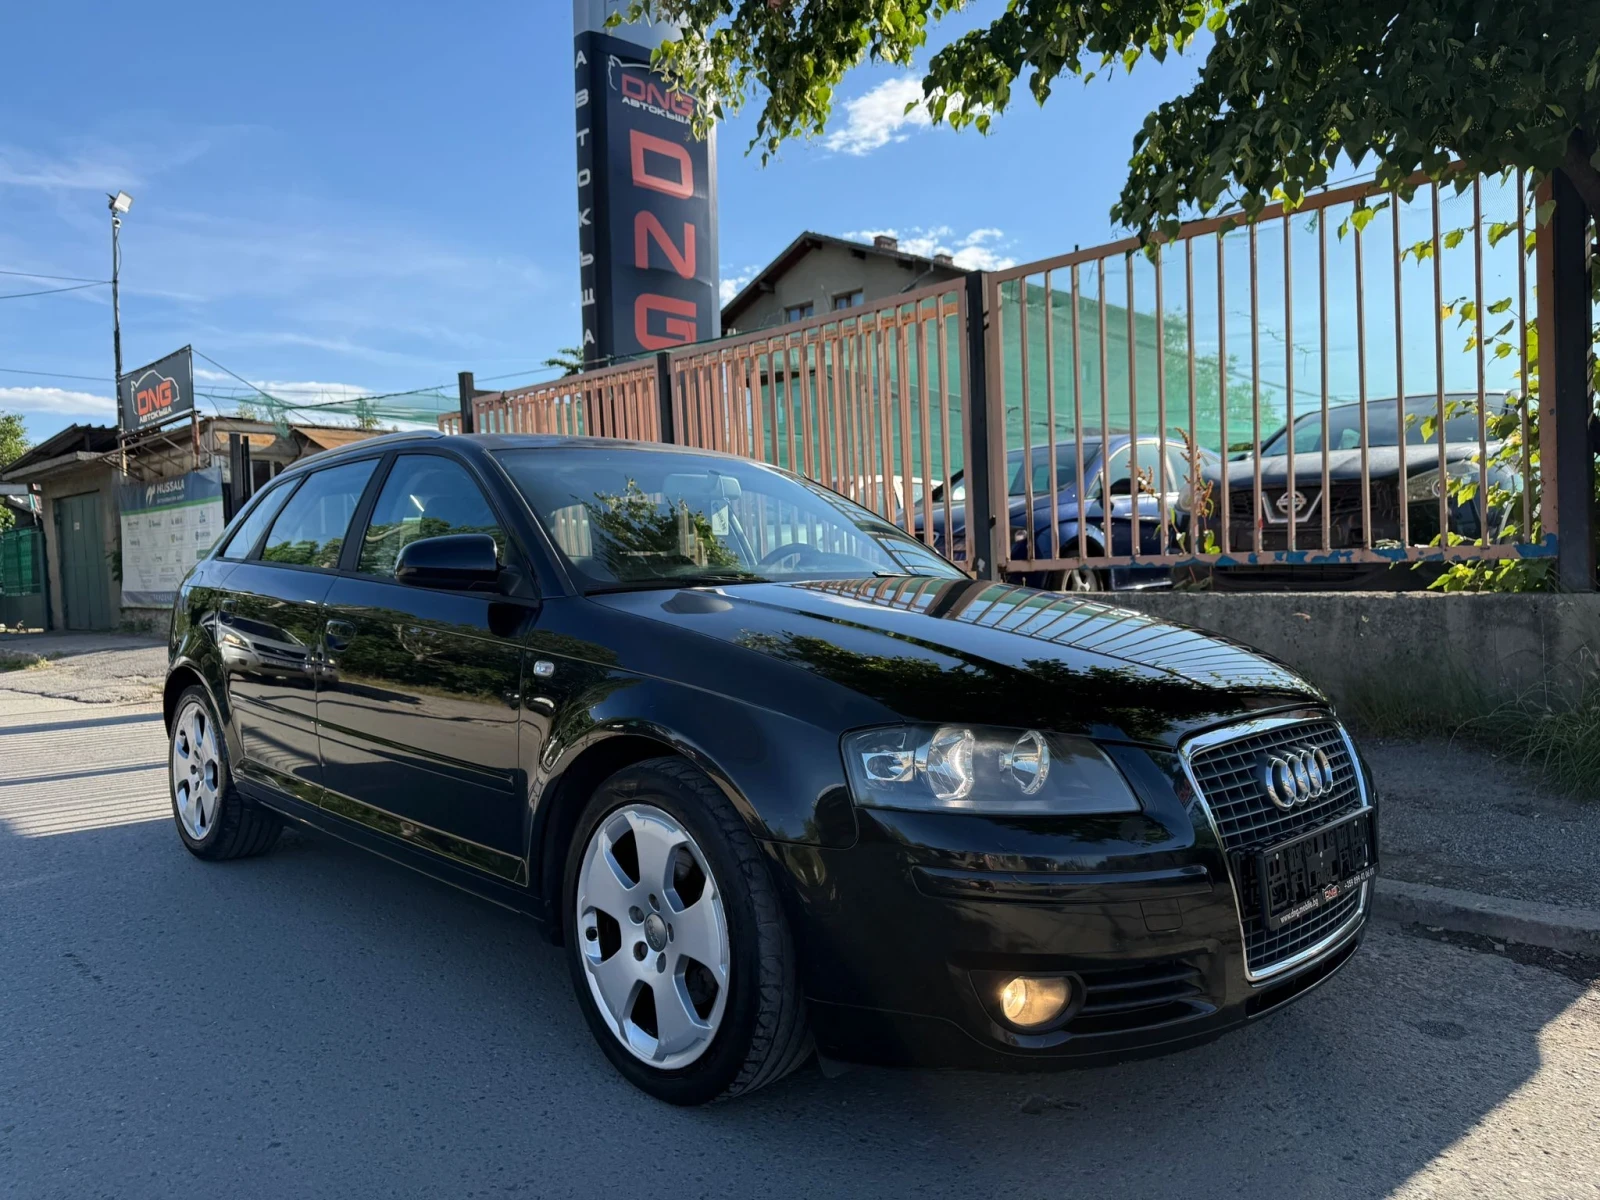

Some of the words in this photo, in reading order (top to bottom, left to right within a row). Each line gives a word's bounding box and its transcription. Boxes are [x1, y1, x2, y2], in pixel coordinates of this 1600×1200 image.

[621, 73, 694, 116] DNG
[629, 128, 697, 351] DNG
[136, 380, 173, 416] DNG
[156, 478, 185, 495] MUSSALA
